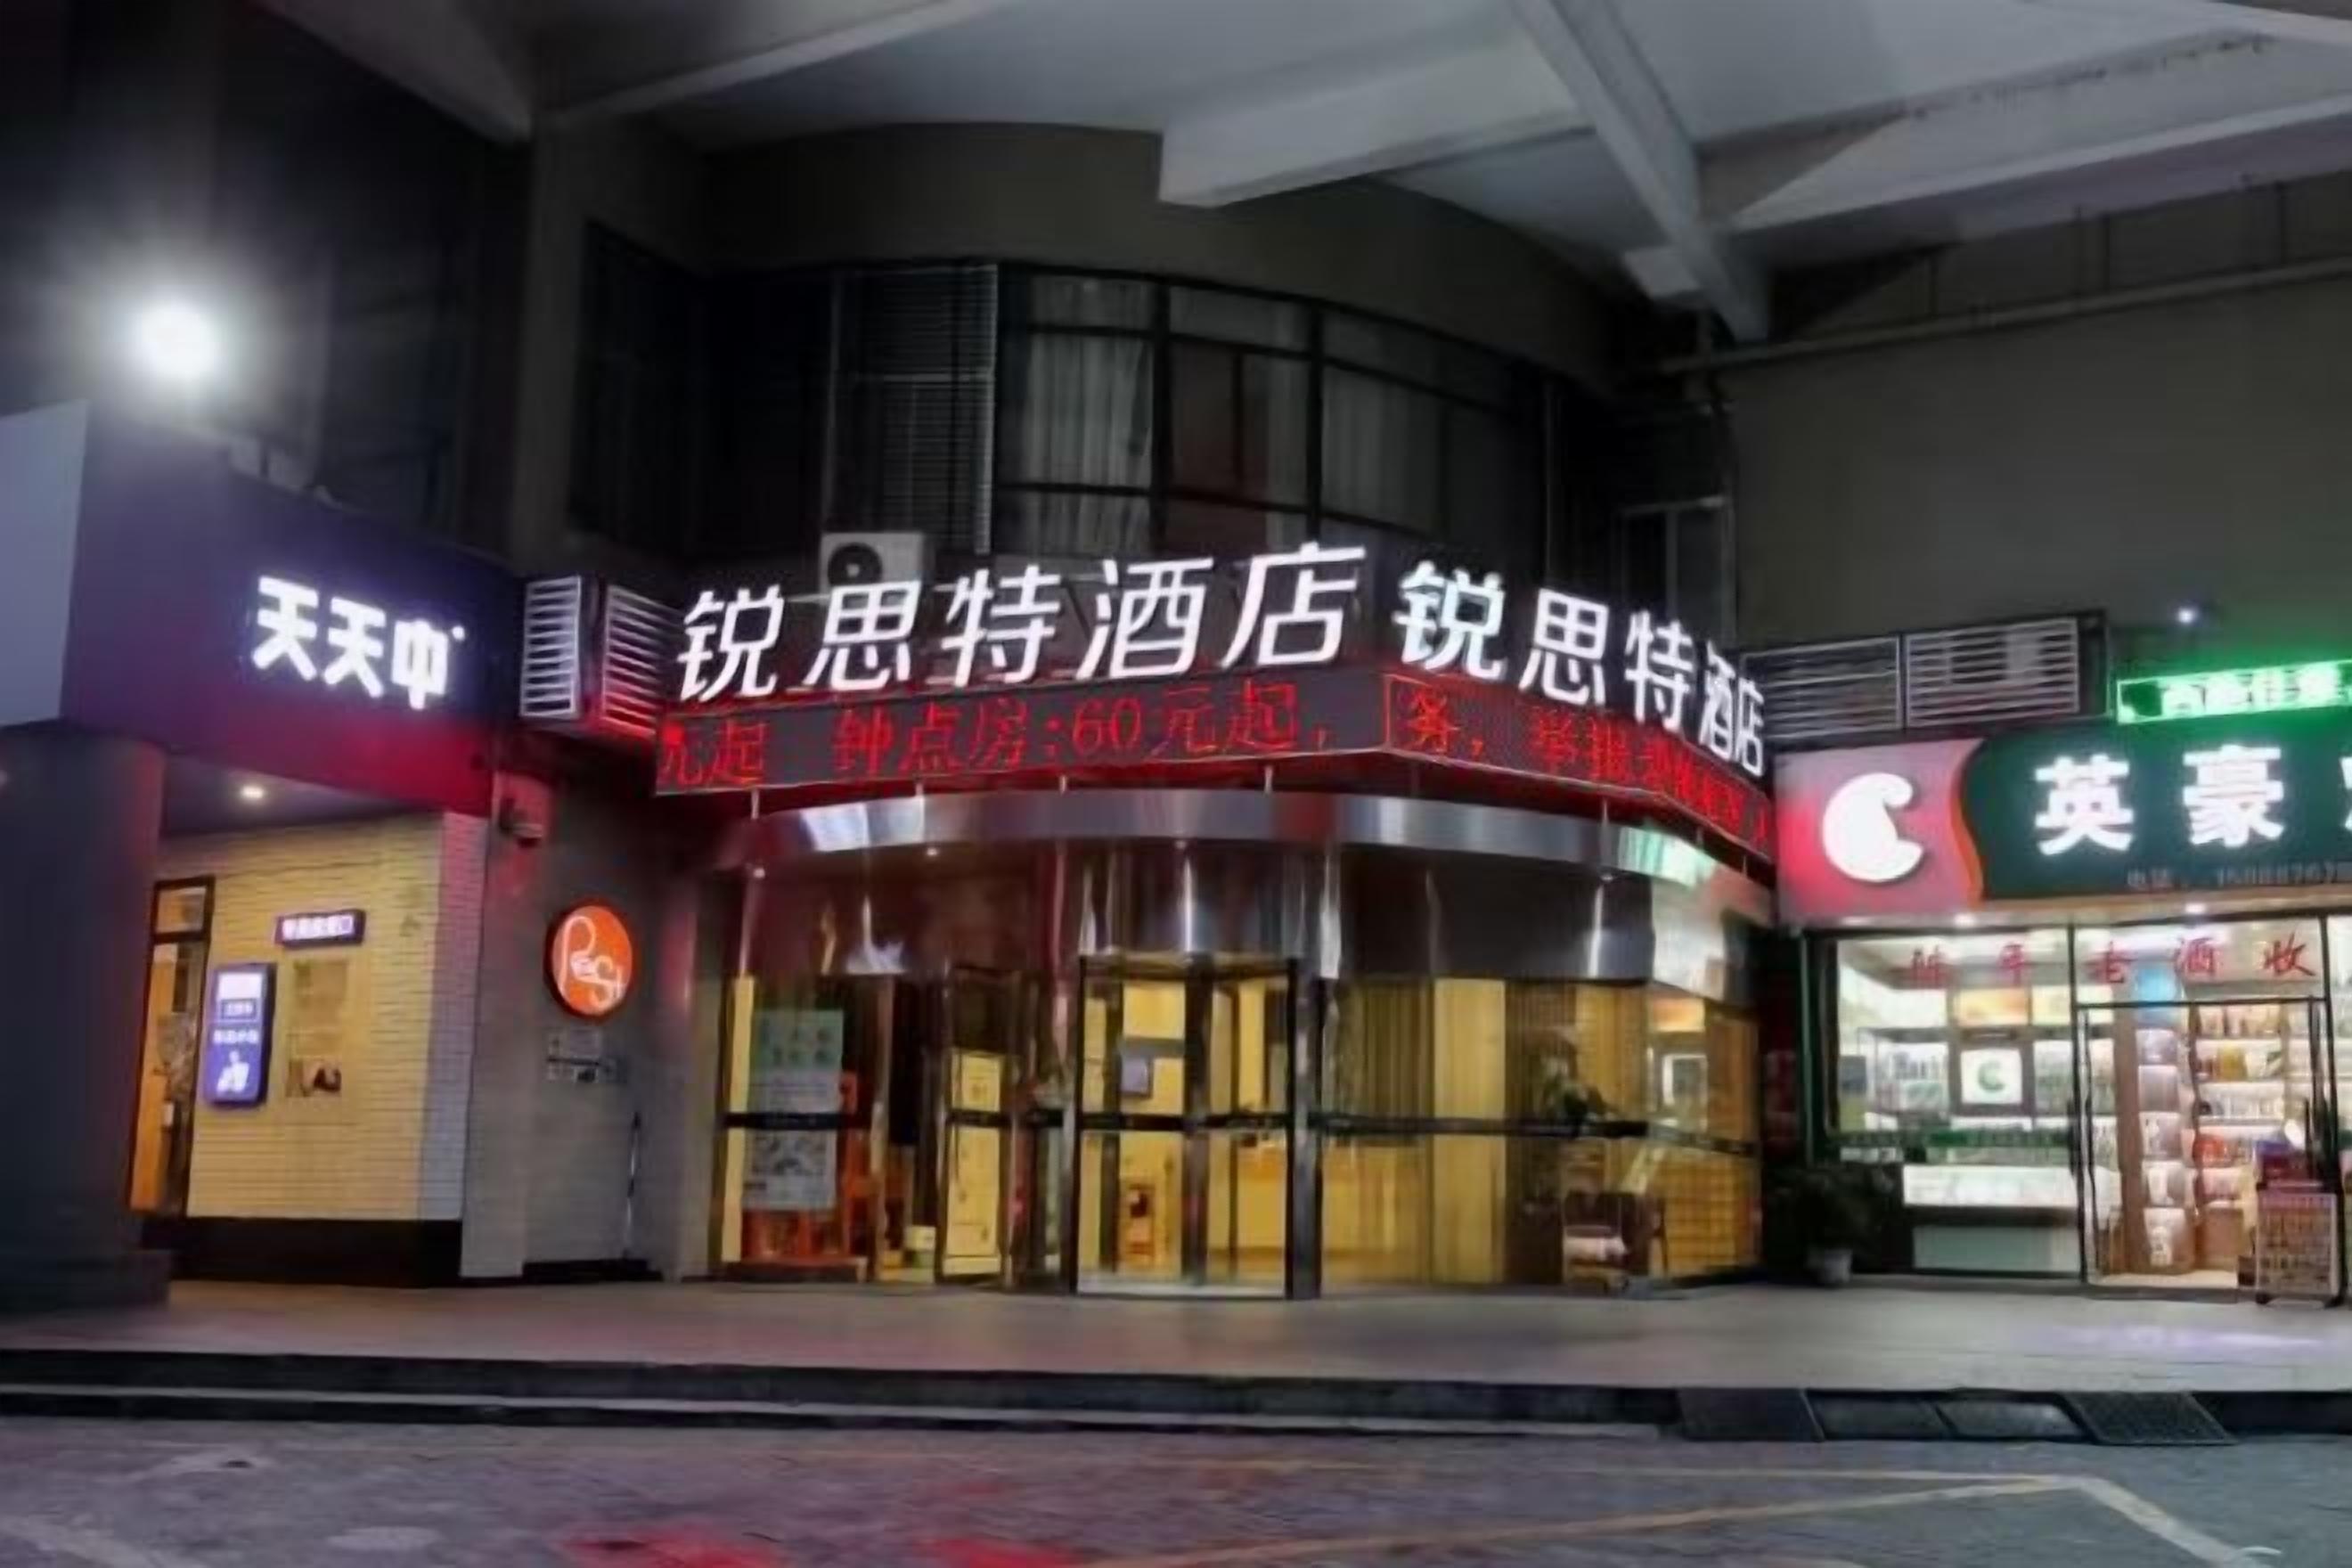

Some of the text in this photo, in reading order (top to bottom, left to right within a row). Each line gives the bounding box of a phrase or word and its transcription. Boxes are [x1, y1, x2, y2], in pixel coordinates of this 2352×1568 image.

[253, 576, 450, 710] 天天中
[676, 541, 1365, 702] 锐思特酒店
[1392, 560, 1765, 777] 锐思特酒店
[2034, 743, 2352, 855] 英豪
